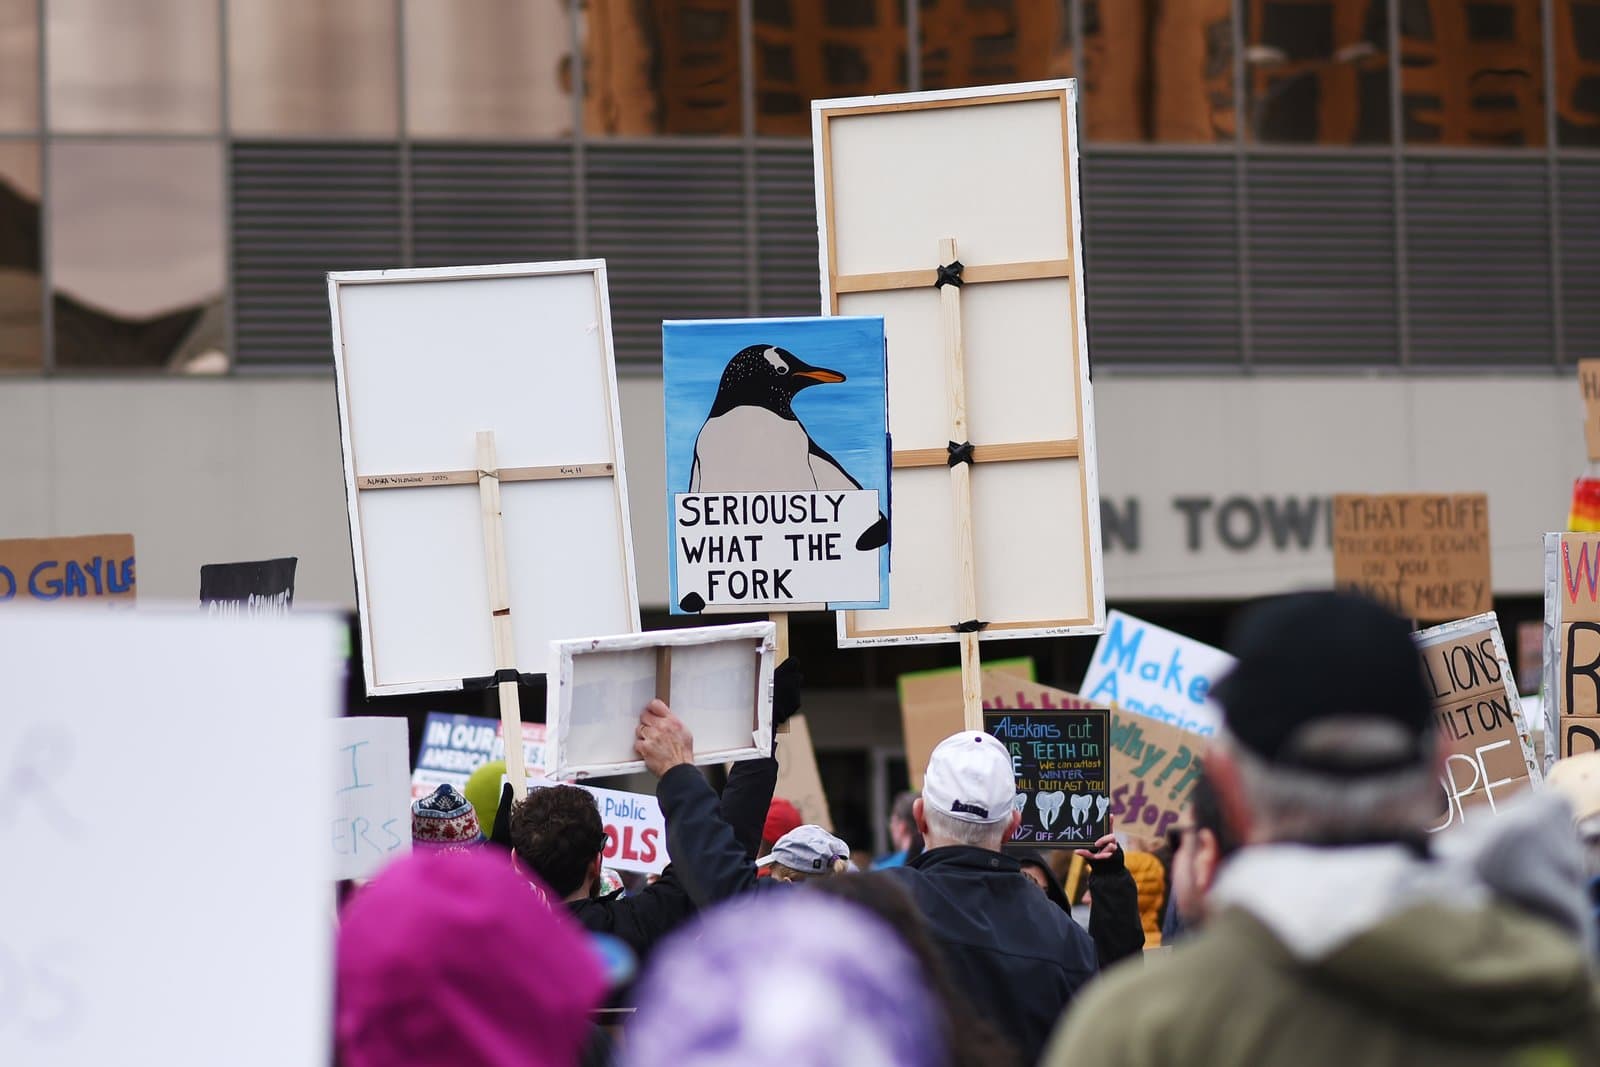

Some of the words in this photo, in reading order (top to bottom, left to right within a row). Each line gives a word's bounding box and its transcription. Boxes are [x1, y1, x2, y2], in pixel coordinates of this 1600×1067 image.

[679, 493, 846, 527] SERIOUSLY
[681, 535, 763, 564] WHAT
[785, 533, 842, 561] THE
[28, 556, 136, 601] GAYLE
[708, 569, 794, 601] FORK
[1415, 580, 1484, 611] MONEY
[1101, 619, 1209, 705] Make
[993, 716, 1061, 738] Alaskans
[1068, 717, 1093, 738] cut
[1434, 695, 1513, 741] ILTON
[1026, 741, 1076, 760] TEETH
[1038, 780, 1083, 791] OUTLAST
[1086, 780, 1104, 791] YOU
[1039, 769, 1084, 780] WINTER
[605, 797, 647, 821] Public
[1035, 831, 1054, 841] OFF
